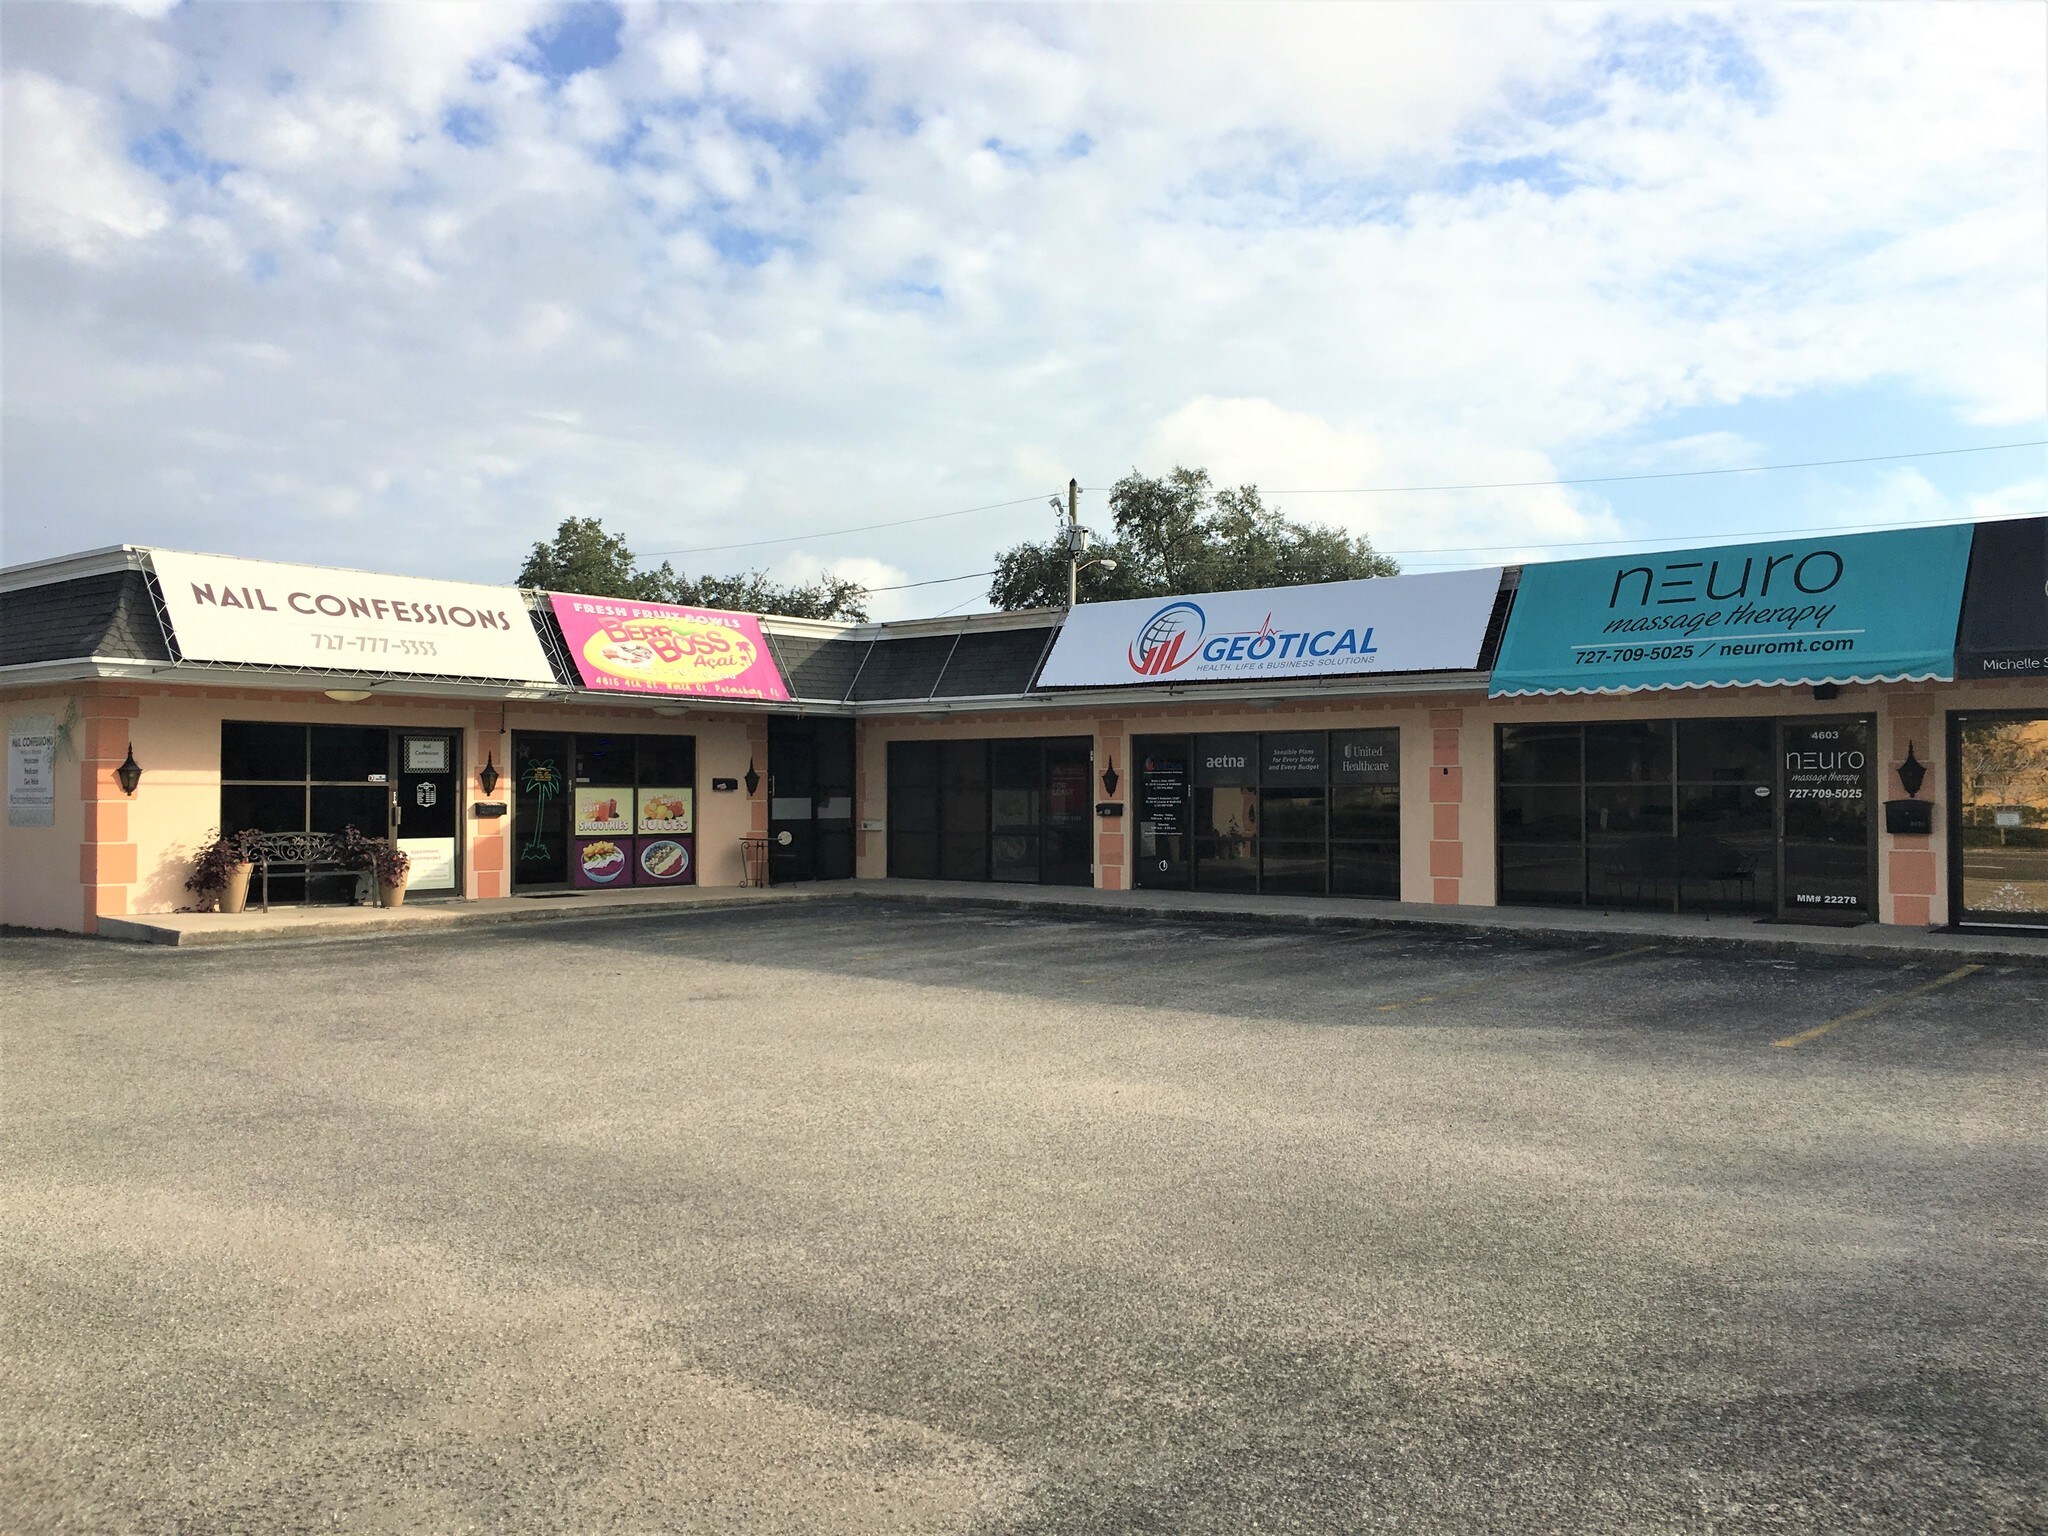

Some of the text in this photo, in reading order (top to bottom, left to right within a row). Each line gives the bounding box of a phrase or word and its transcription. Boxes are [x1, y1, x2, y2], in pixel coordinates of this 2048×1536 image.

[190, 582, 511, 631] NAIL CONFESSIONS
[573, 602, 741, 629] FRESH FRUIT BOWLS
[1602, 601, 1837, 637] massage therapy
[647, 629, 731, 663] BOSS
[1202, 627, 1378, 662] GEOTICAL
[1575, 644, 1695, 664] 727-709-5025
[1719, 638, 1854, 656] neuromt.com
[1235, 662, 1255, 670] LIFE
[1257, 662, 1264, 670] &
[1266, 659, 1315, 669] BUSINESS
[1317, 655, 1376, 666] SOLUTIONS
[1983, 657, 2040, 671] Michelle
[624, 677, 641, 689] 4th
[646, 679, 662, 691] St.
[666, 681, 692, 692] North
[696, 684, 711, 693] St.
[769, 687, 780, 697] FL
[1811, 731, 1839, 740] 4603
[1353, 746, 1383, 757] United
[1206, 755, 1245, 768] aetna
[1282, 756, 1299, 764] Every
[1299, 756, 1316, 764] Body
[1342, 760, 1389, 772] Healthcare
[1280, 764, 1297, 772] Every
[1297, 764, 1320, 772] Budget
[1791, 771, 1860, 785] massage therapy
[1789, 788, 1863, 799] 727-709-5025
[579, 821, 629, 831] SMOOTHIES
[638, 819, 689, 831] JUICES
[1796, 894, 1858, 905] MM# 22278
